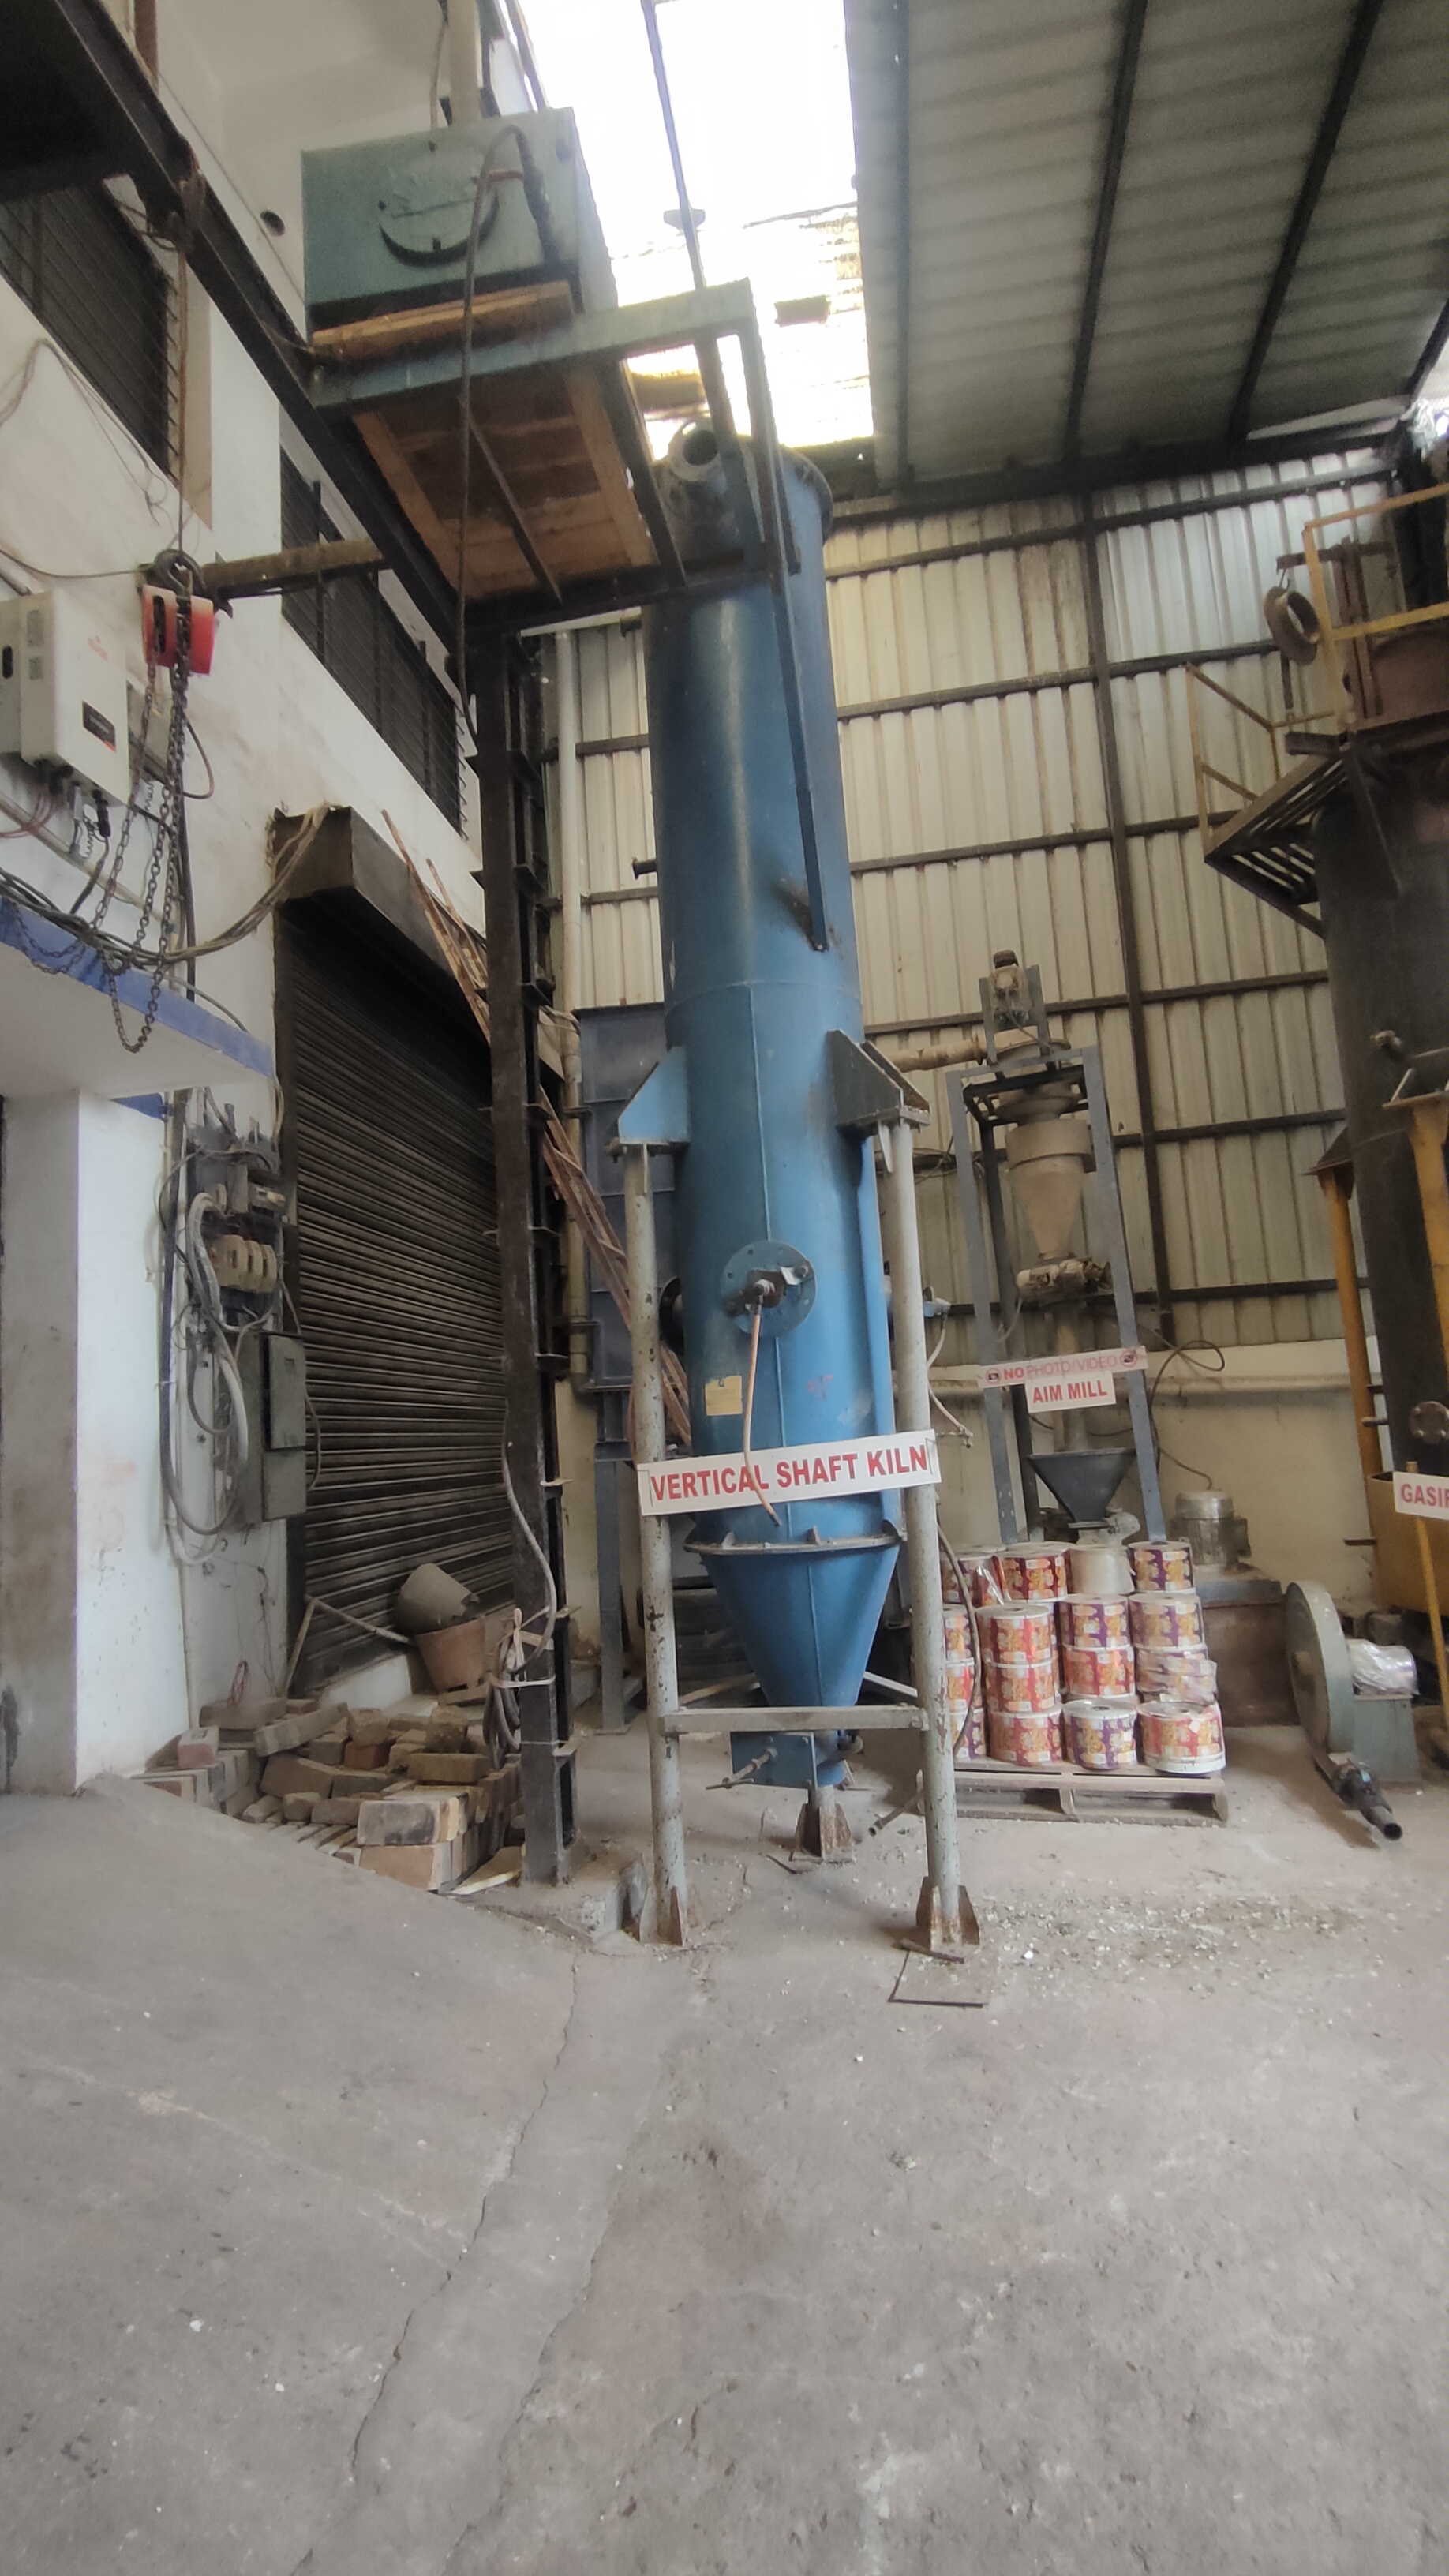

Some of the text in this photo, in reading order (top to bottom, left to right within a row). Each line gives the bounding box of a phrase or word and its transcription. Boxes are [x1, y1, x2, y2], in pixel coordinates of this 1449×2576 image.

[1004, 1368, 1024, 1380] NO
[1033, 1380, 1107, 1403] AIM MILL
[651, 1445, 927, 1501] VERTICAL SHAFT KILN
